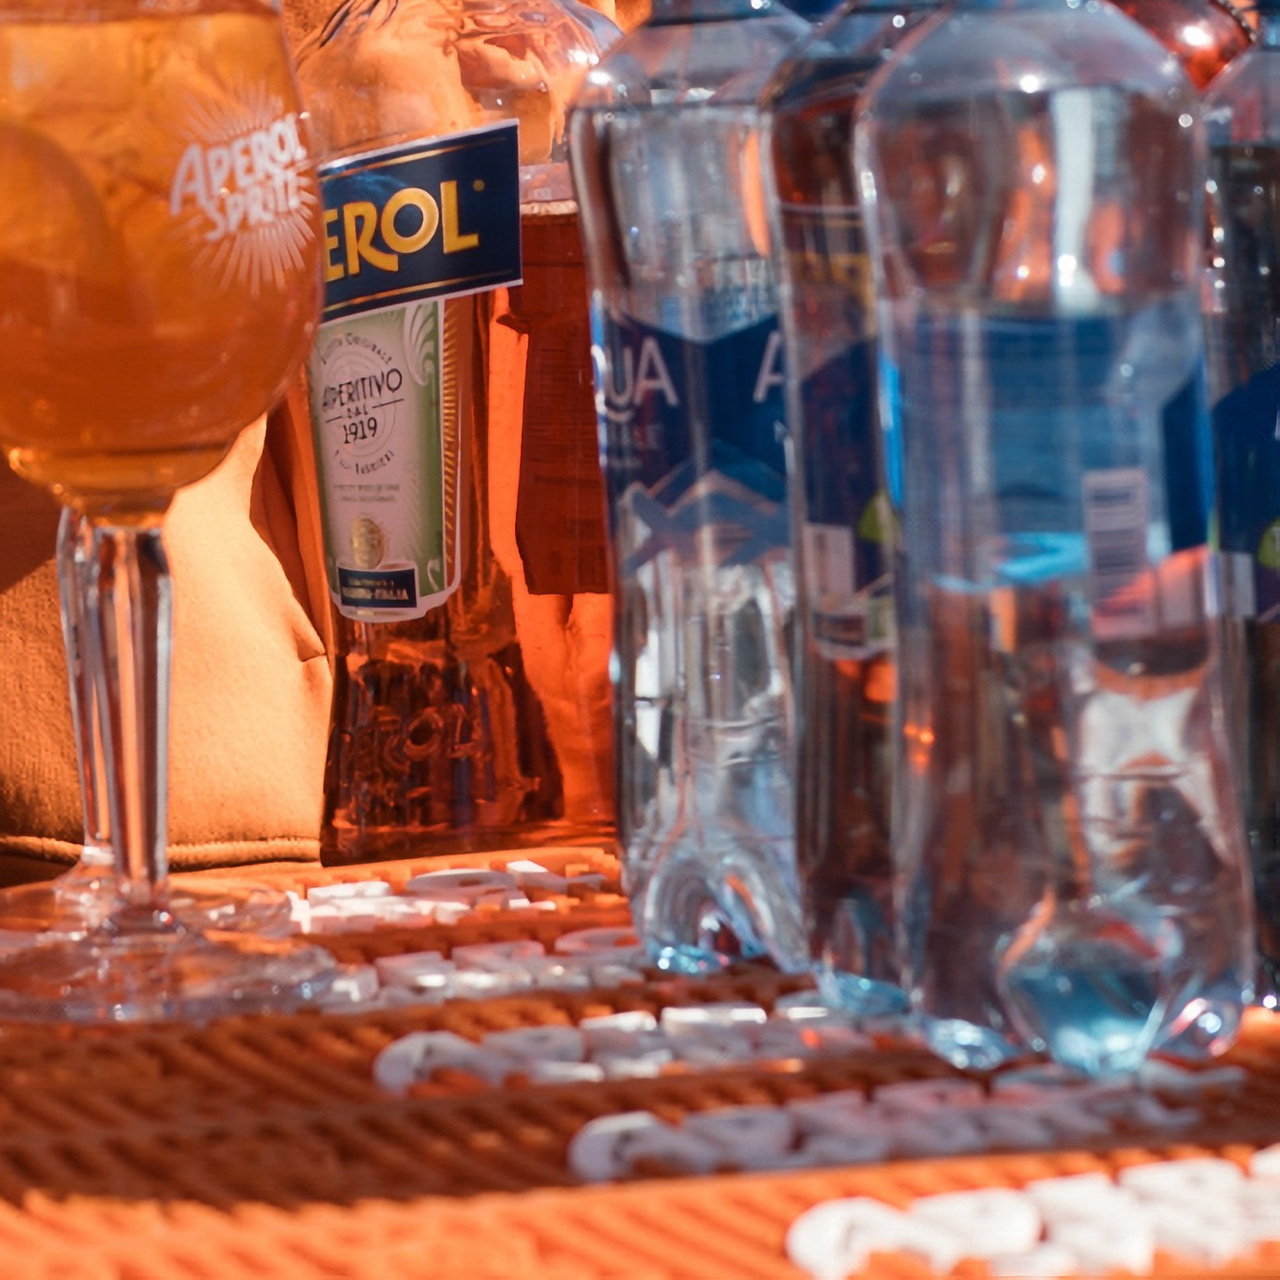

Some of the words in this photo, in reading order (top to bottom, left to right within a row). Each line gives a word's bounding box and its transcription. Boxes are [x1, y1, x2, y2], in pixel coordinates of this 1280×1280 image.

[169, 113, 307, 216] APEROL
[322, 368, 403, 411] APERITIVO
[343, 416, 378, 444] 1919
